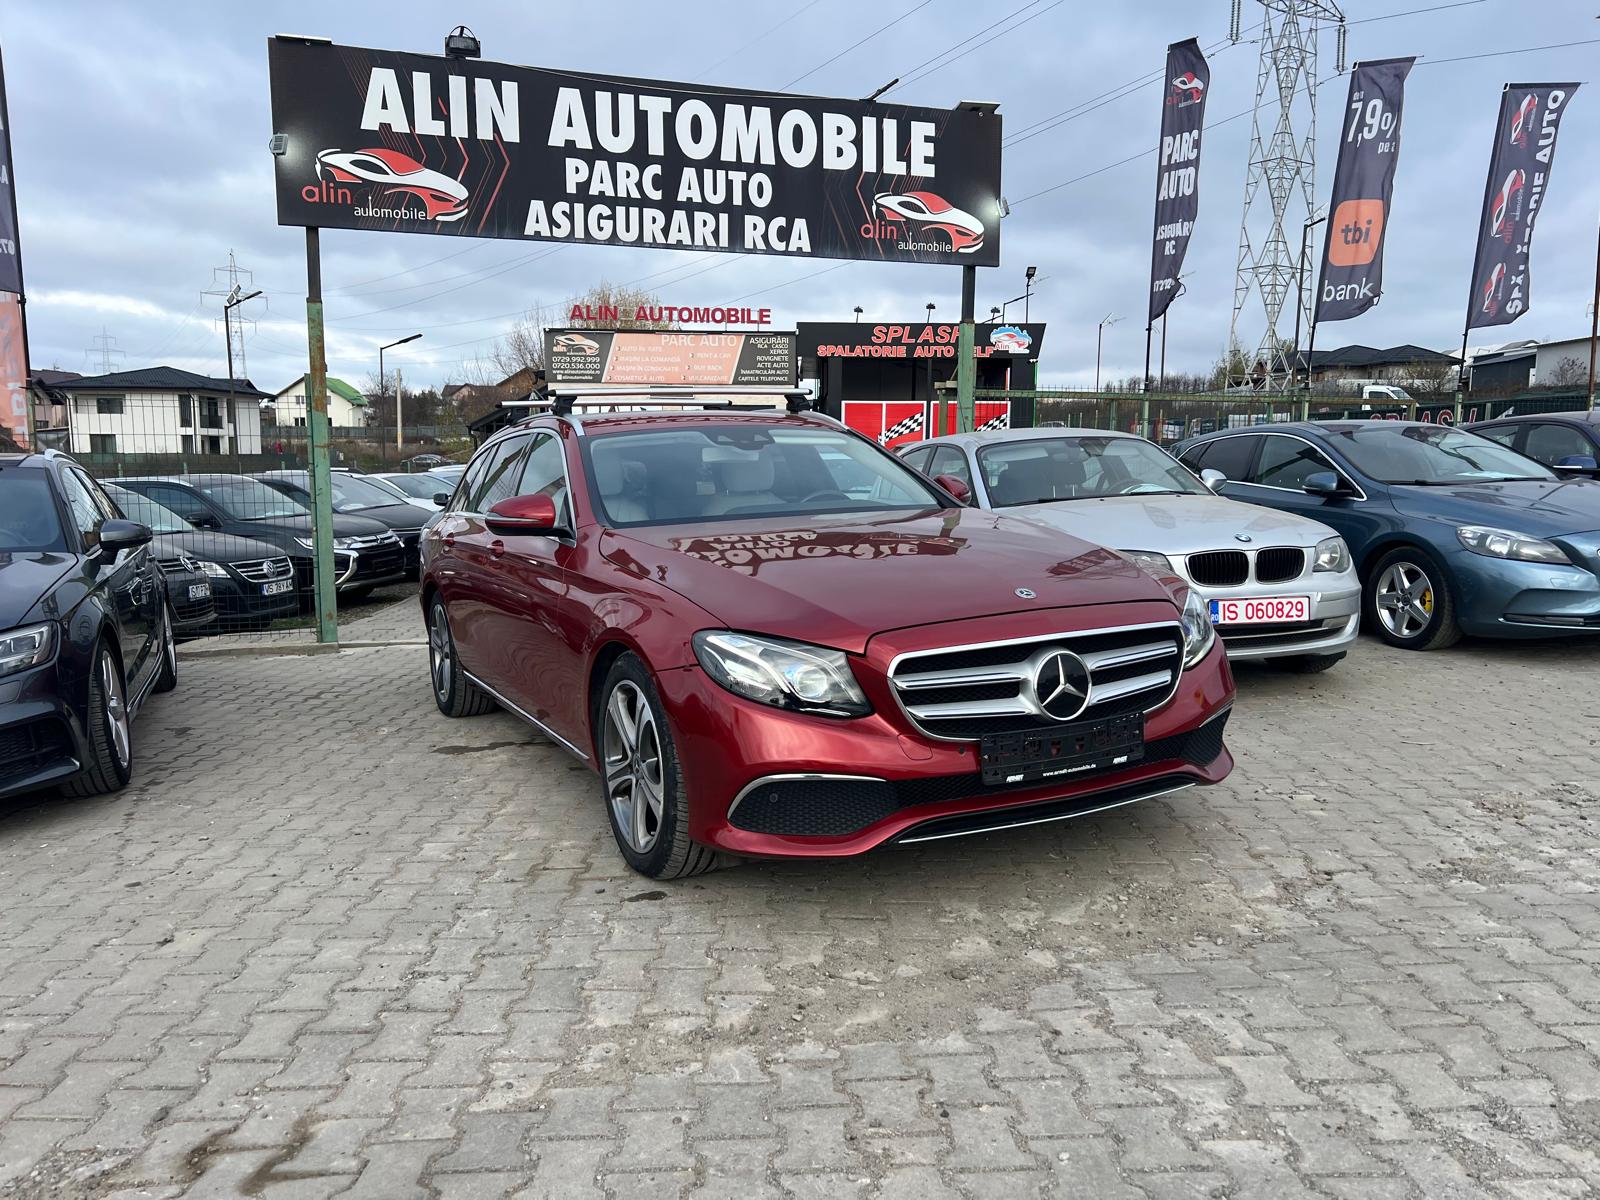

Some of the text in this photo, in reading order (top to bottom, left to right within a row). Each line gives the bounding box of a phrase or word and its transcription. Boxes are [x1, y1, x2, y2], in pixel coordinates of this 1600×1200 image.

[360, 67, 936, 178] ALIN AUTOMOBILE
[1536, 90, 1565, 163] AUTO
[1162, 129, 1198, 166] PARC
[301, 180, 352, 204] alin
[565, 157, 772, 208] PARC AUTO
[1158, 167, 1195, 201] AUTO
[354, 197, 426, 220] automobile
[524, 200, 811, 252] ASIGURARI RCA
[860, 219, 897, 240] alin
[1341, 220, 1372, 245] tbi
[898, 233, 951, 252] automobile
[1322, 278, 1373, 302] bank
[570, 304, 771, 325] ALIN AUTOMOBILE
[661, 335, 737, 347] PARC AUTO
[817, 344, 906, 358] SPALATORIE
[914, 345, 955, 358] AUTO
[1222, 601, 1304, 621] IS 060829
